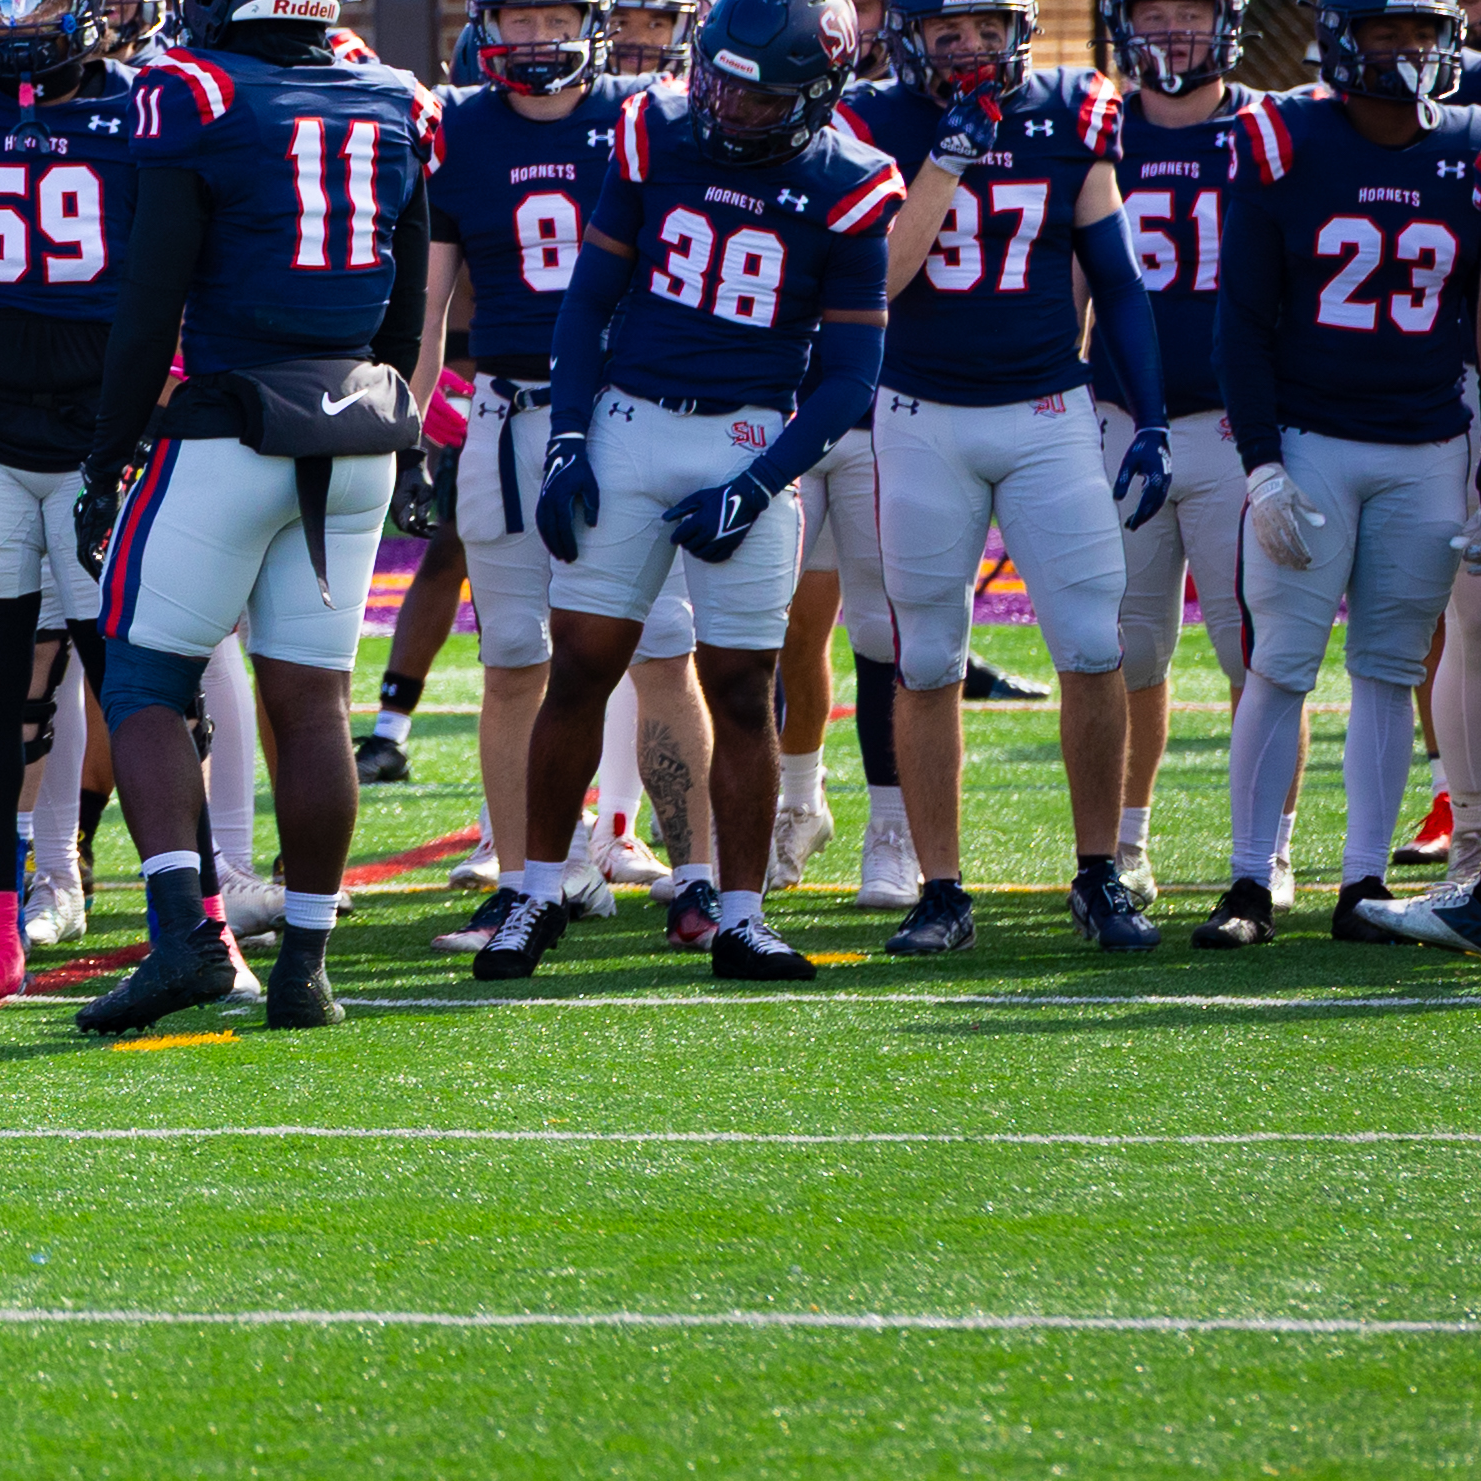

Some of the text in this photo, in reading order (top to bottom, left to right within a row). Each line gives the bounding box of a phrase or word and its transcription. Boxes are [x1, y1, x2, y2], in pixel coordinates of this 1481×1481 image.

[134, 85, 163, 138] 11
[285, 115, 382, 271] 11
[510, 163, 577, 183] HORNETS
[704, 185, 765, 215] HORNETS
[1140, 160, 1201, 179] HORNETS
[1358, 186, 1421, 208] HORNETS
[513, 190, 582, 293] 8
[649, 203, 788, 329] 38
[924, 177, 1051, 294] 37
[1122, 187, 1223, 292] 61
[1314, 214, 1459, 335] 23
[730, 420, 768, 449] SU
